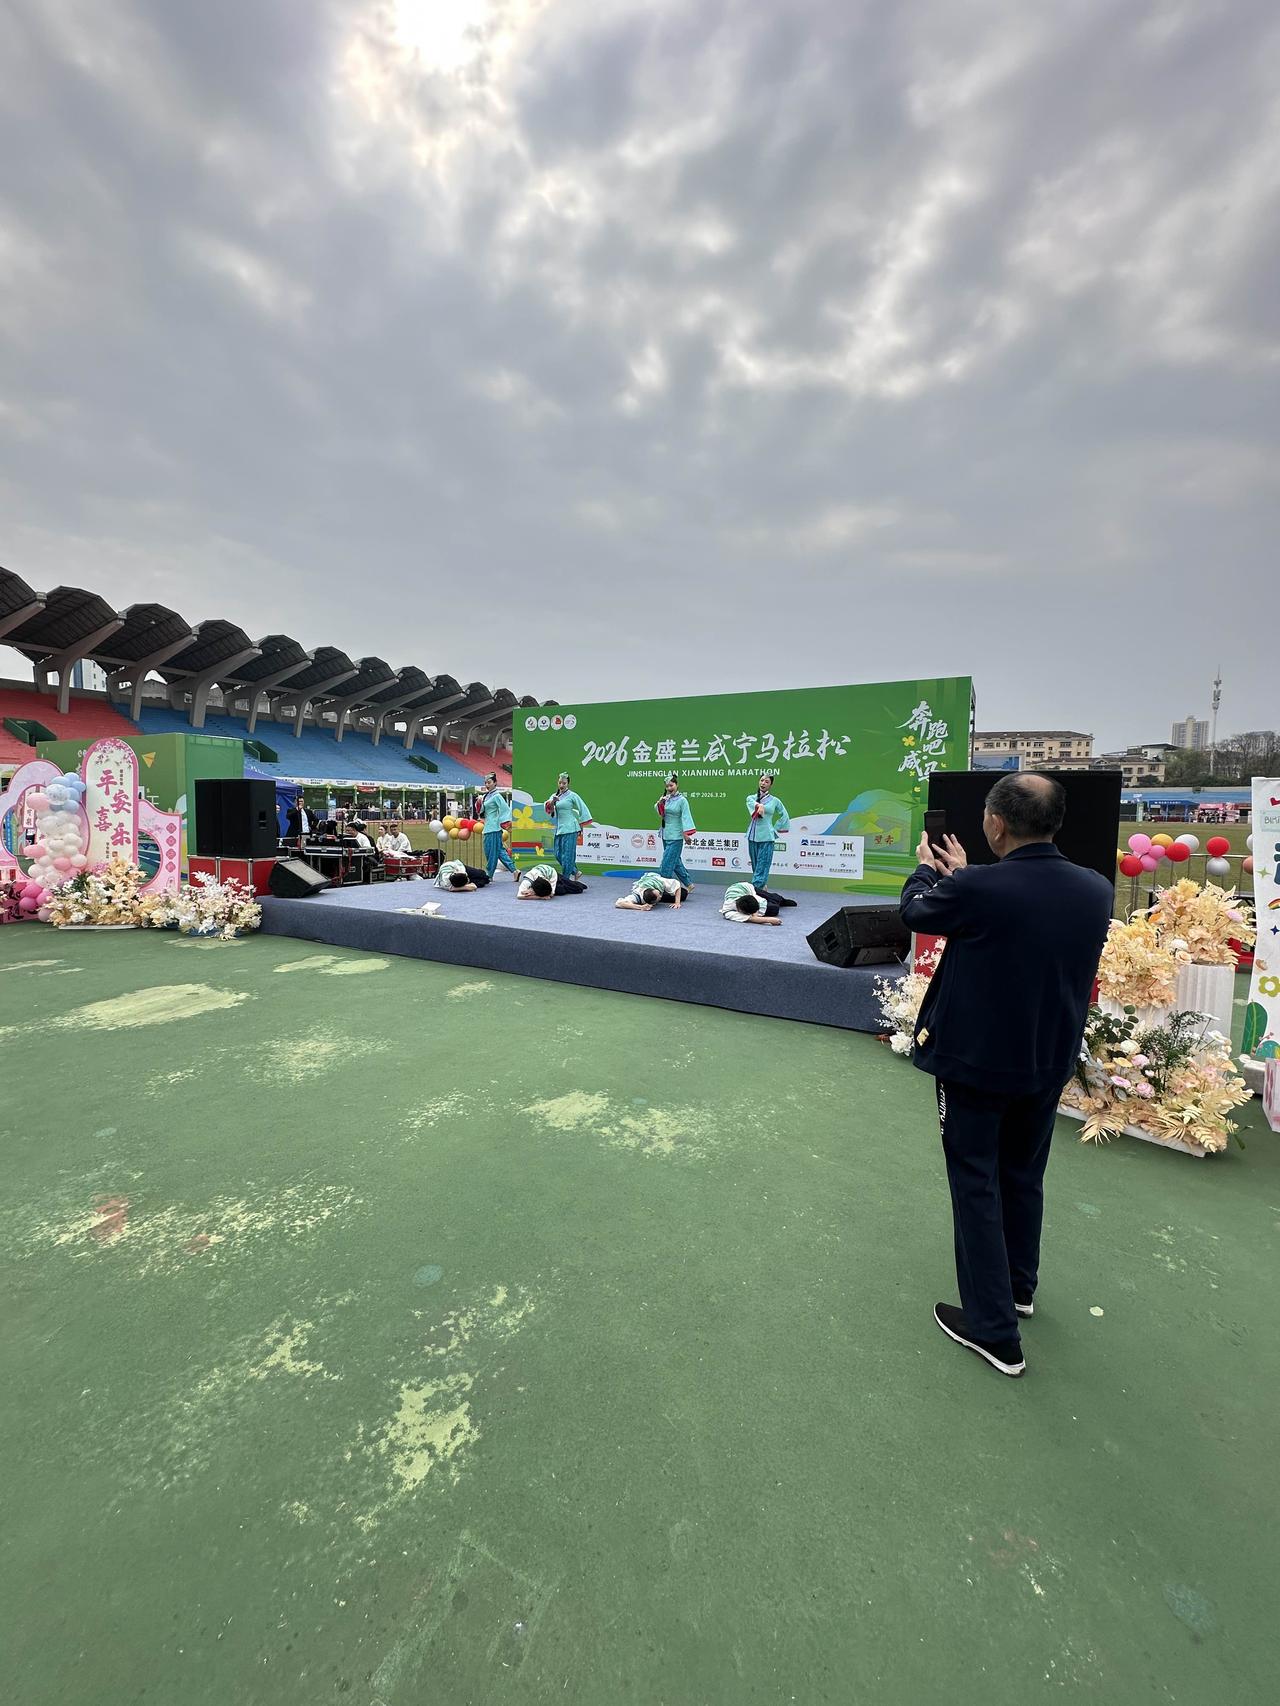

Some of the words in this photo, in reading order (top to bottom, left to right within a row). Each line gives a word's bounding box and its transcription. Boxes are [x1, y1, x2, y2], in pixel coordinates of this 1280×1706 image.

[626, 770, 679, 778] JINSHENGLAN
[681, 769, 725, 777] XIANNING
[727, 768, 780, 776] MARATHON
[94, 768, 132, 847] 平安喜乐
